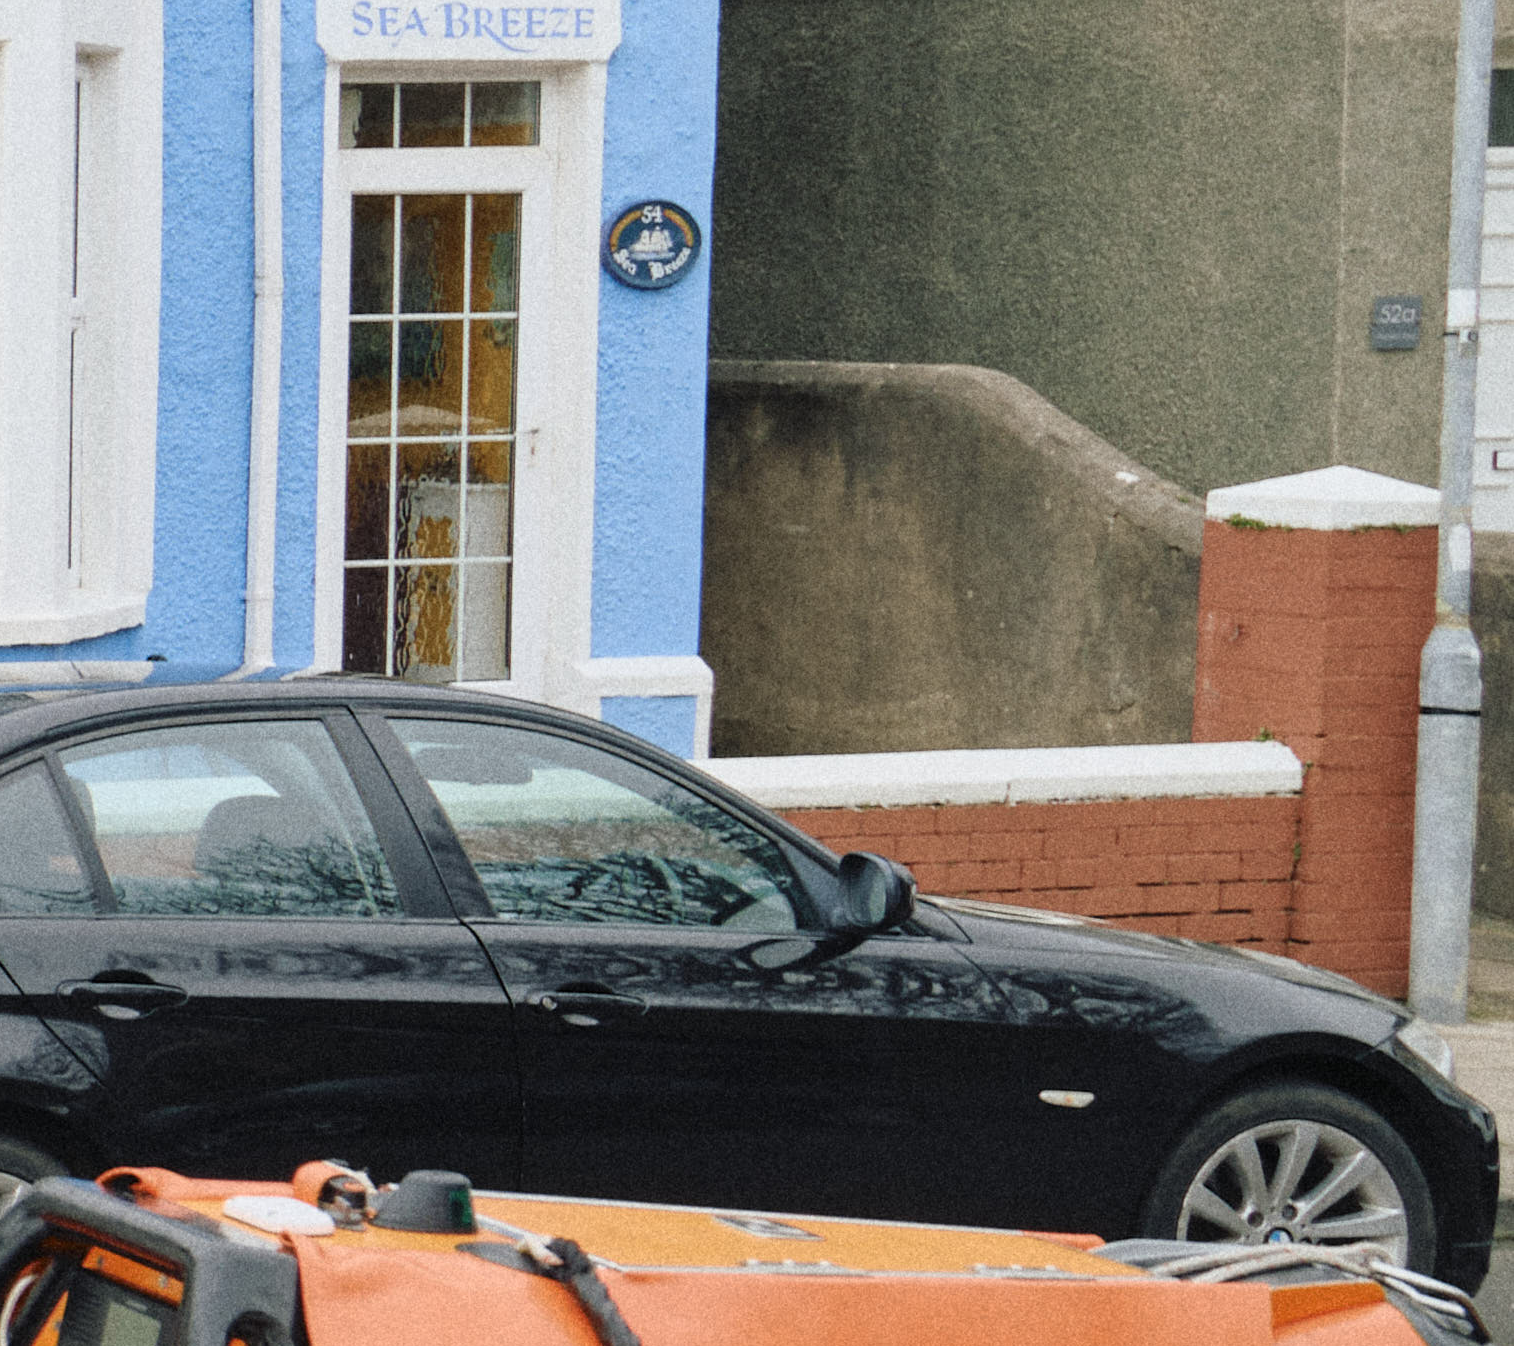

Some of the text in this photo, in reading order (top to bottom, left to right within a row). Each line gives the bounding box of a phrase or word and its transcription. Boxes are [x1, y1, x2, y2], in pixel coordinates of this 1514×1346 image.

[351, 0, 596, 53] SEA BREEZE
[641, 205, 663, 223] 54
